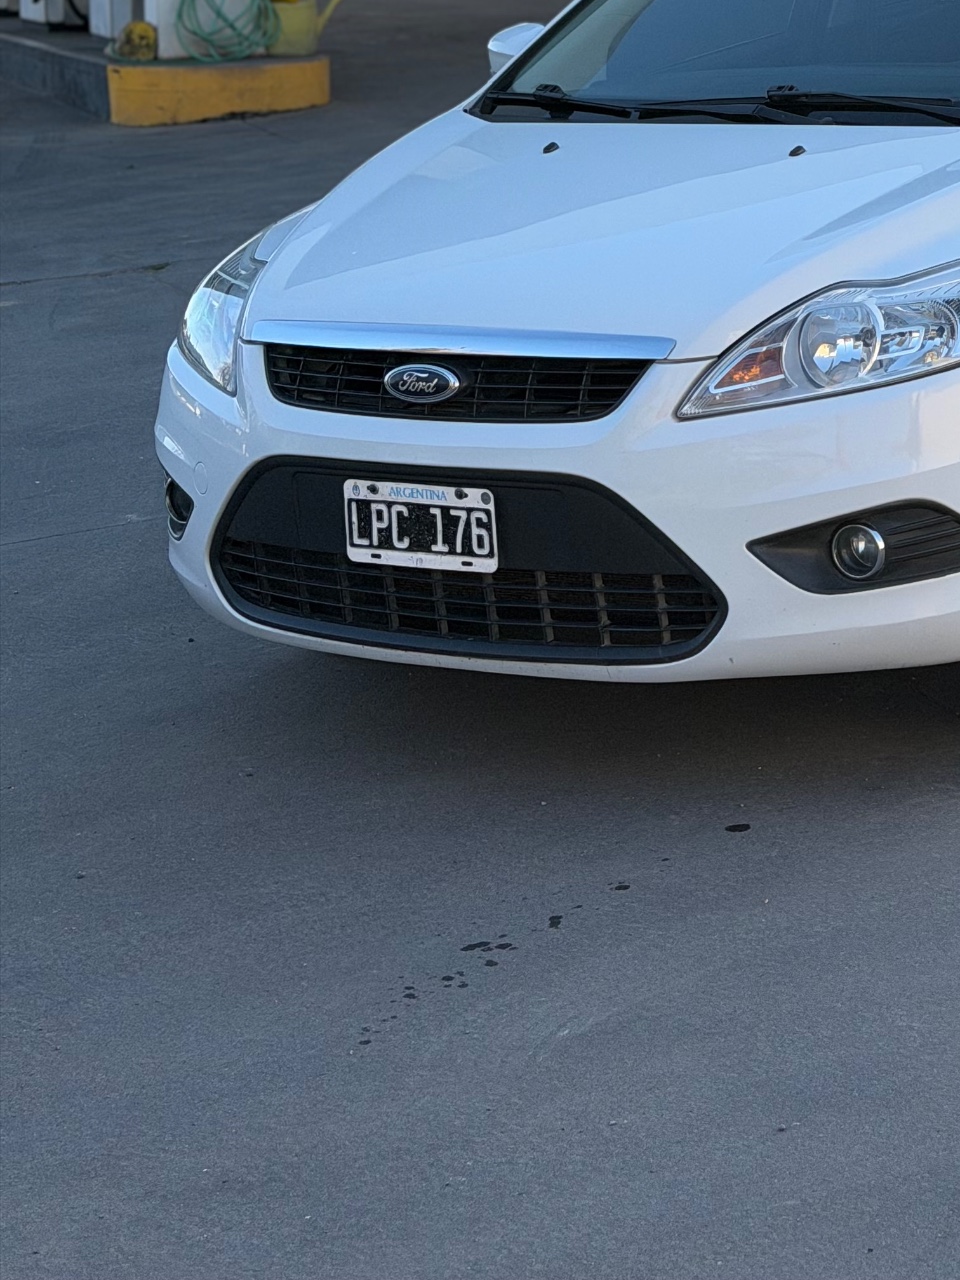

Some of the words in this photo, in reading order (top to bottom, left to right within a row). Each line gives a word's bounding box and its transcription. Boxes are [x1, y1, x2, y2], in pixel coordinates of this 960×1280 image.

[399, 371, 438, 394] Ford
[388, 486, 448, 502] ARGENTINA
[351, 501, 411, 550] LPC
[429, 507, 490, 556] 176
